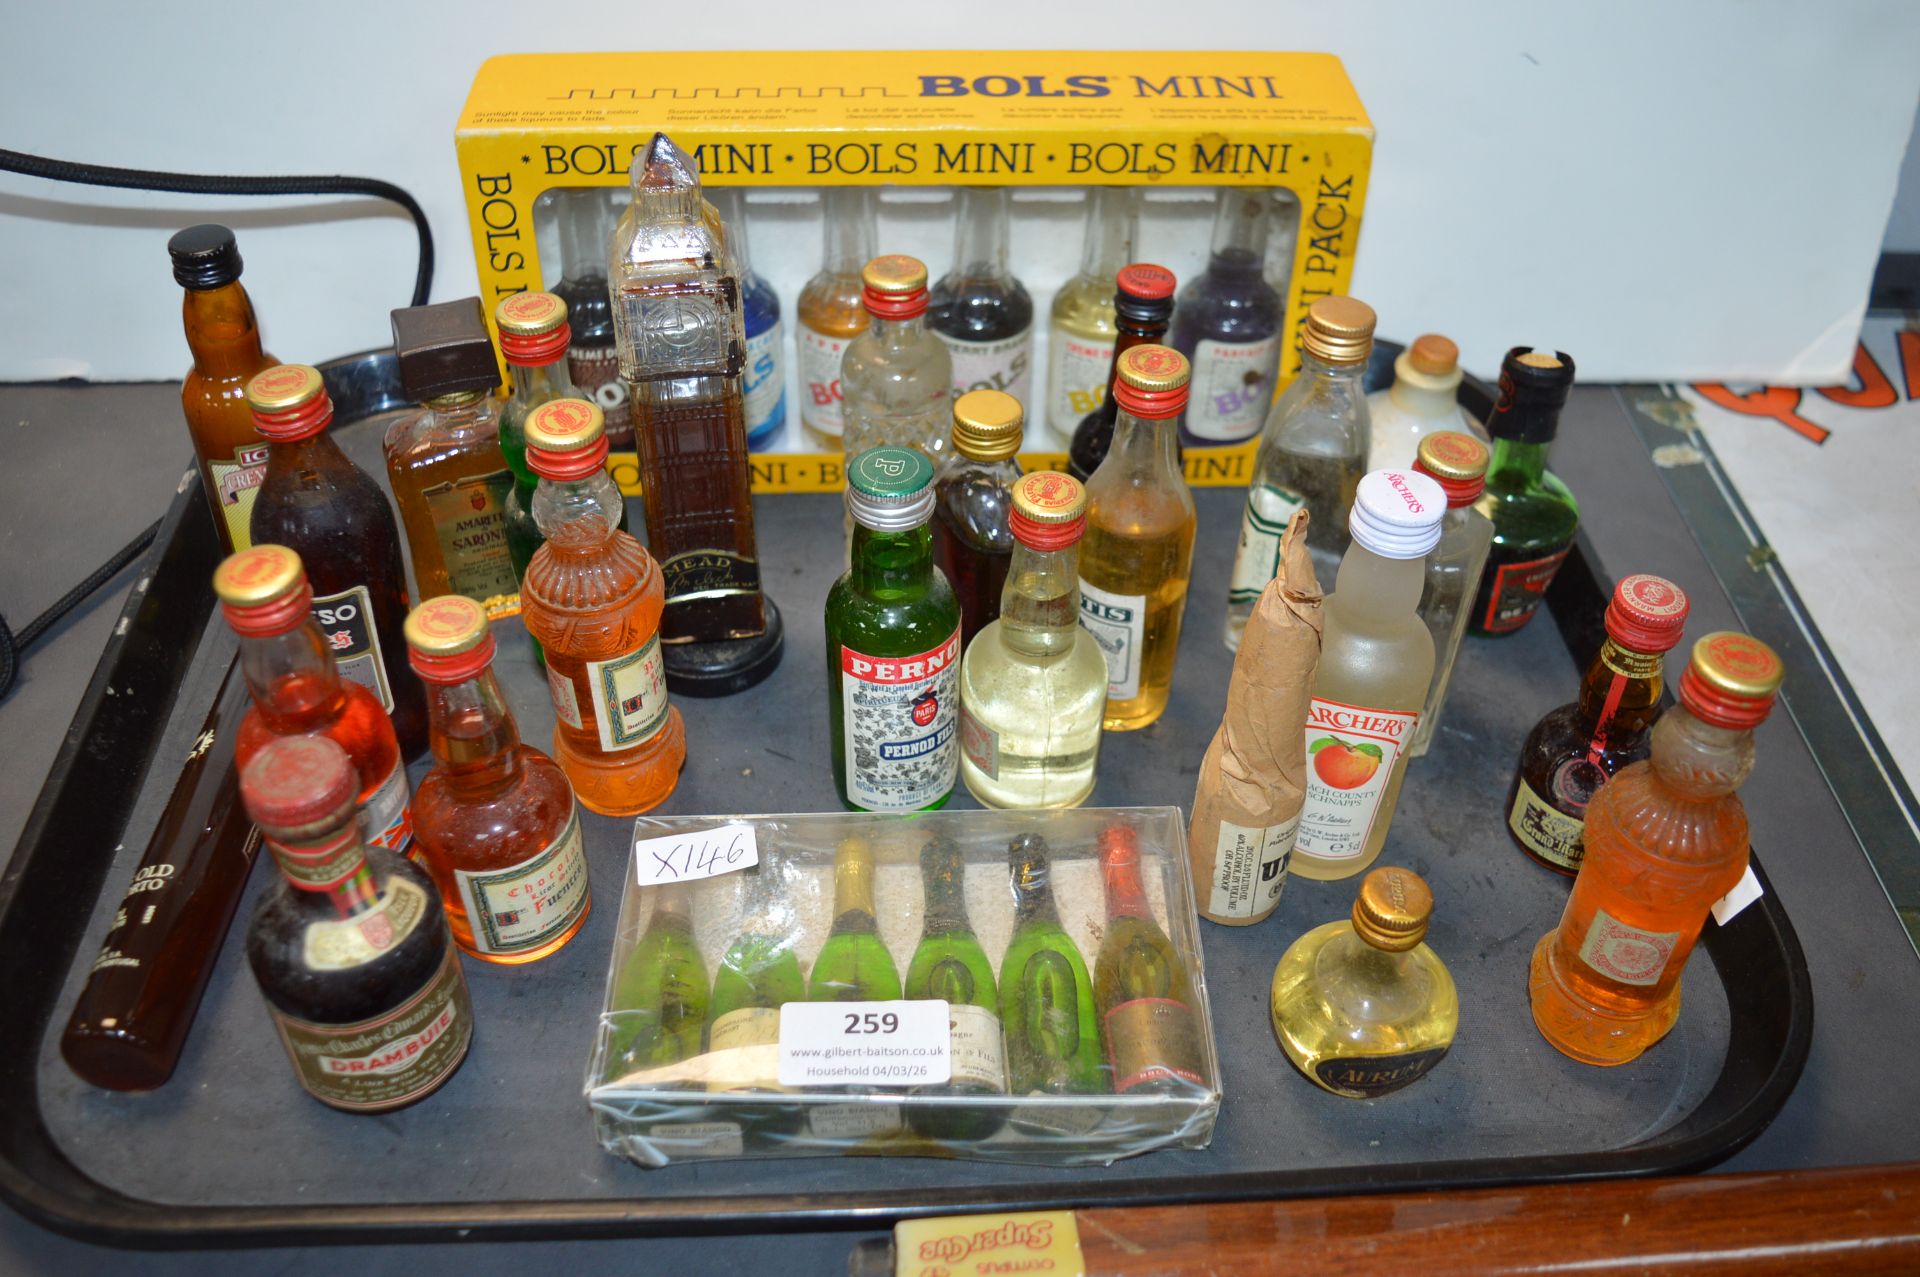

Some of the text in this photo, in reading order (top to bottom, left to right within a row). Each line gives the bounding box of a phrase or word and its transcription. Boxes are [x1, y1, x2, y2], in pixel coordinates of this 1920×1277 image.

[918, 75, 1284, 99] BOLS MINI
[807, 143, 917, 174] BOLS
[934, 143, 1036, 174] MINI
[1067, 143, 1177, 174] BOLS
[1193, 143, 1293, 174] MINI
[477, 172, 525, 272] BOLS
[1305, 174, 1354, 279] PACK
[915, 704, 936, 718] PARIS
[884, 738, 935, 758] PERNOD
[1332, 790, 1377, 799] COUNTY
[652, 833, 744, 878] X146
[844, 1012, 900, 1034] 259
[329, 1009, 451, 1073] DRAMBUIE
[790, 1045, 944, 1059] www.gilbert-baitson.co.uk
[807, 1064, 928, 1078] Household 04/03/26
